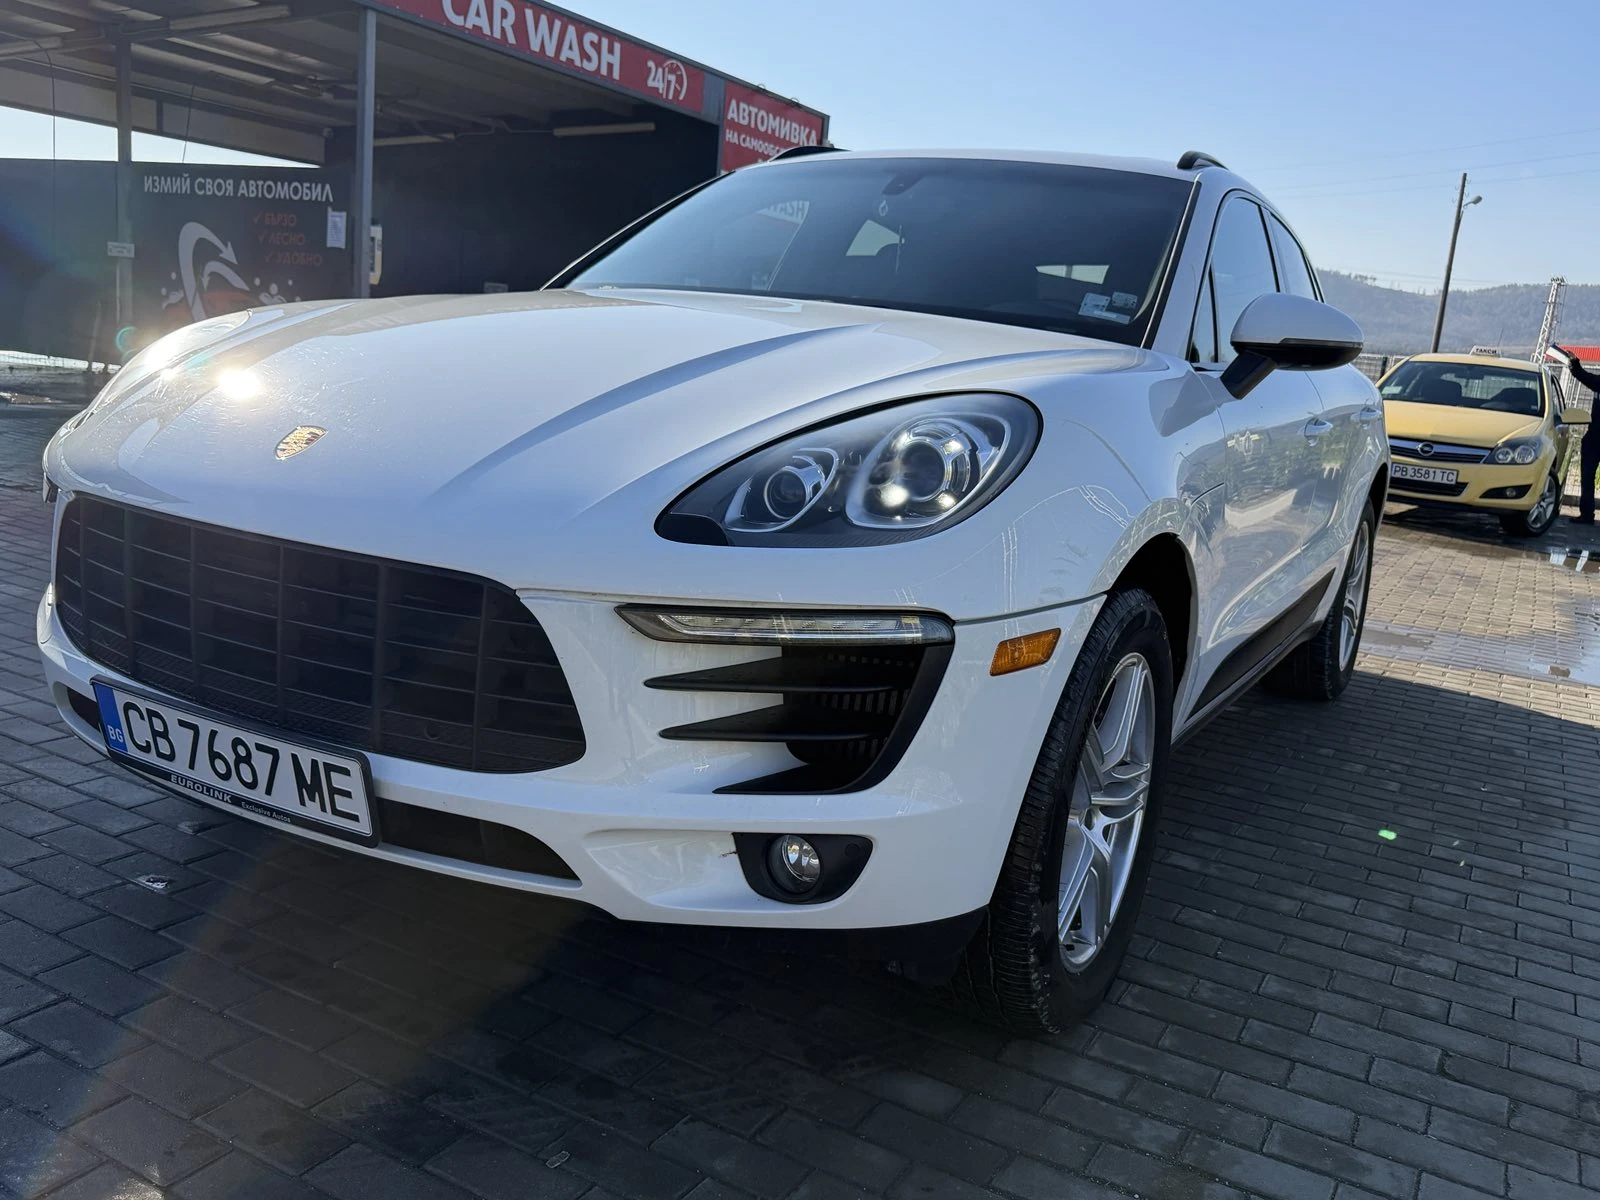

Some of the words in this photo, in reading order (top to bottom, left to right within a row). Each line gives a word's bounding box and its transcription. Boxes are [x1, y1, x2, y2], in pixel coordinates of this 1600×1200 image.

[442, 0, 517, 44] CAR
[524, 8, 621, 81] WASH
[725, 129, 739, 145] НА
[727, 98, 817, 146] АВТОМИВКА
[144, 173, 190, 194] ИЗМИЙ
[194, 177, 234, 198] СВОЯ
[238, 181, 334, 203] АВТОМОБИЛ
[107, 724, 124, 743] BG
[170, 774, 232, 804] EUROLINK
[241, 801, 271, 818] Exclusive
[272, 811, 291, 823] Autos
